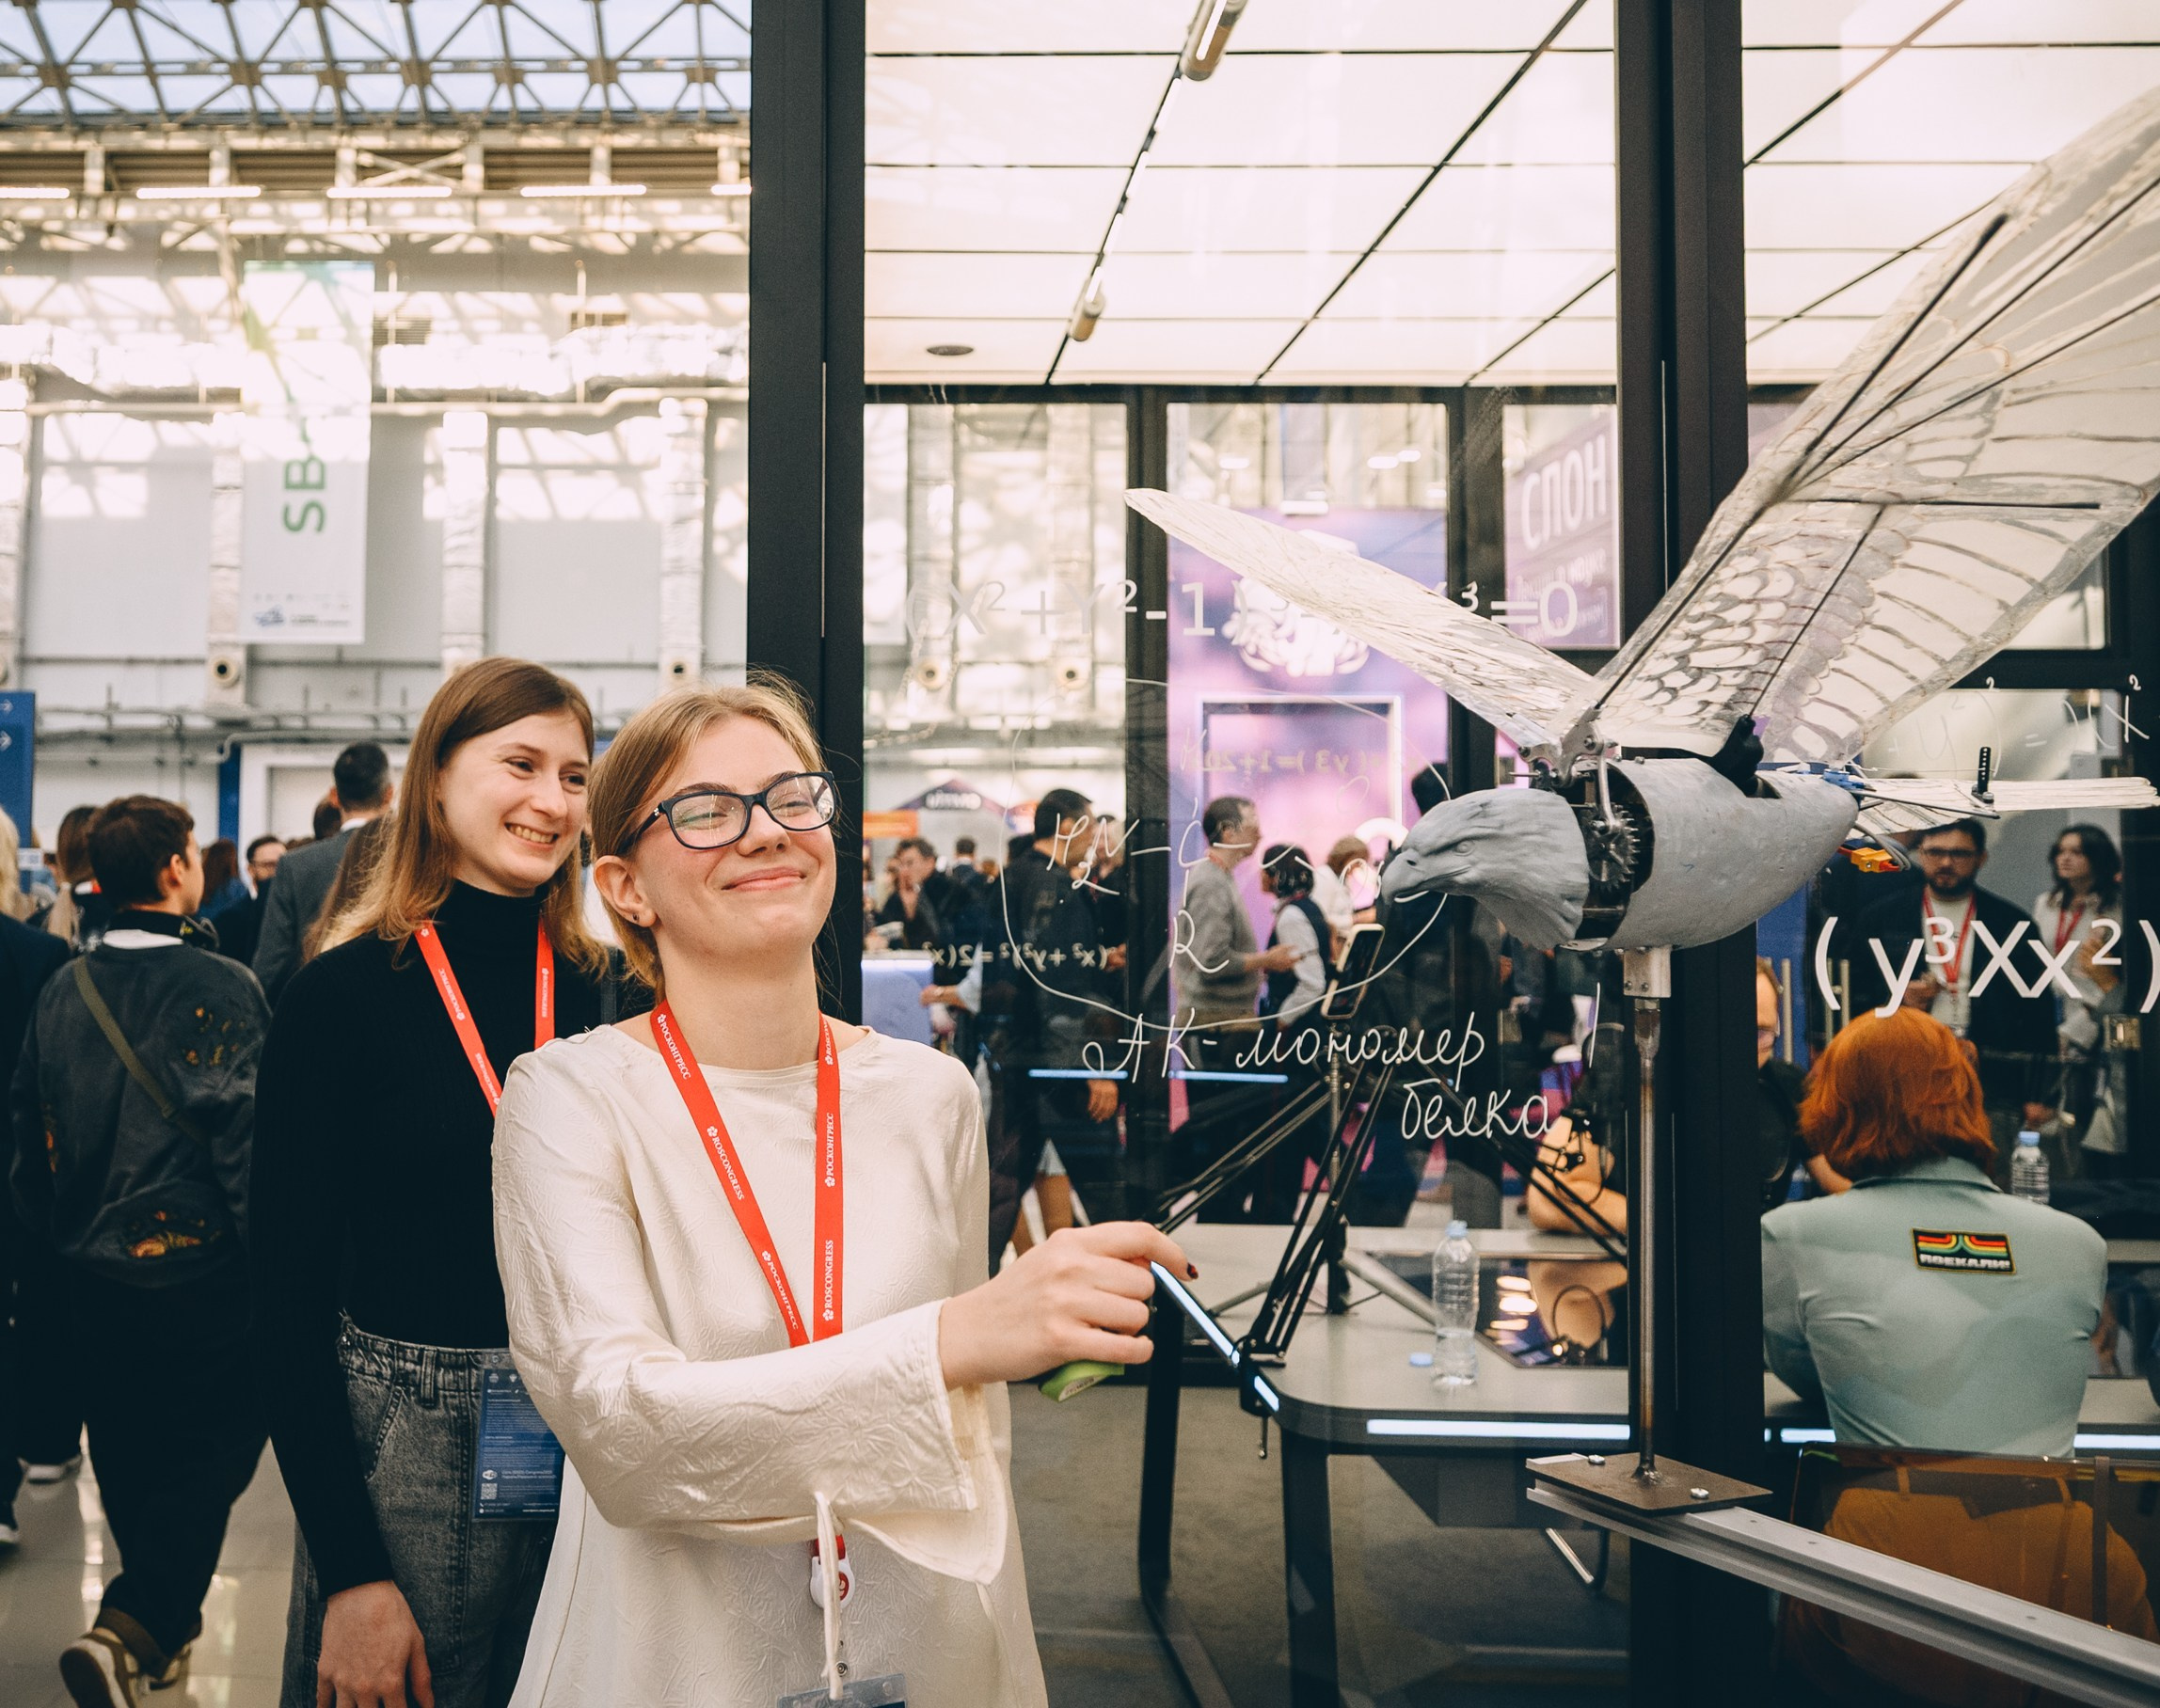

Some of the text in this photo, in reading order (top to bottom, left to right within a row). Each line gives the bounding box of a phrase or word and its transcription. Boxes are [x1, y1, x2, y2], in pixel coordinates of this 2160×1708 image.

[1520, 434, 1607, 551] СПОН
[659, 1021, 691, 1081] РОСКОНГРЕСС
[712, 1136, 745, 1200] ROSCONGRESS
[826, 1113, 834, 1177] РОСКОНГРЕСС
[767, 1261, 799, 1331] РОСКОНГРЕСС
[823, 1240, 834, 1309] ROSCONGRESS
